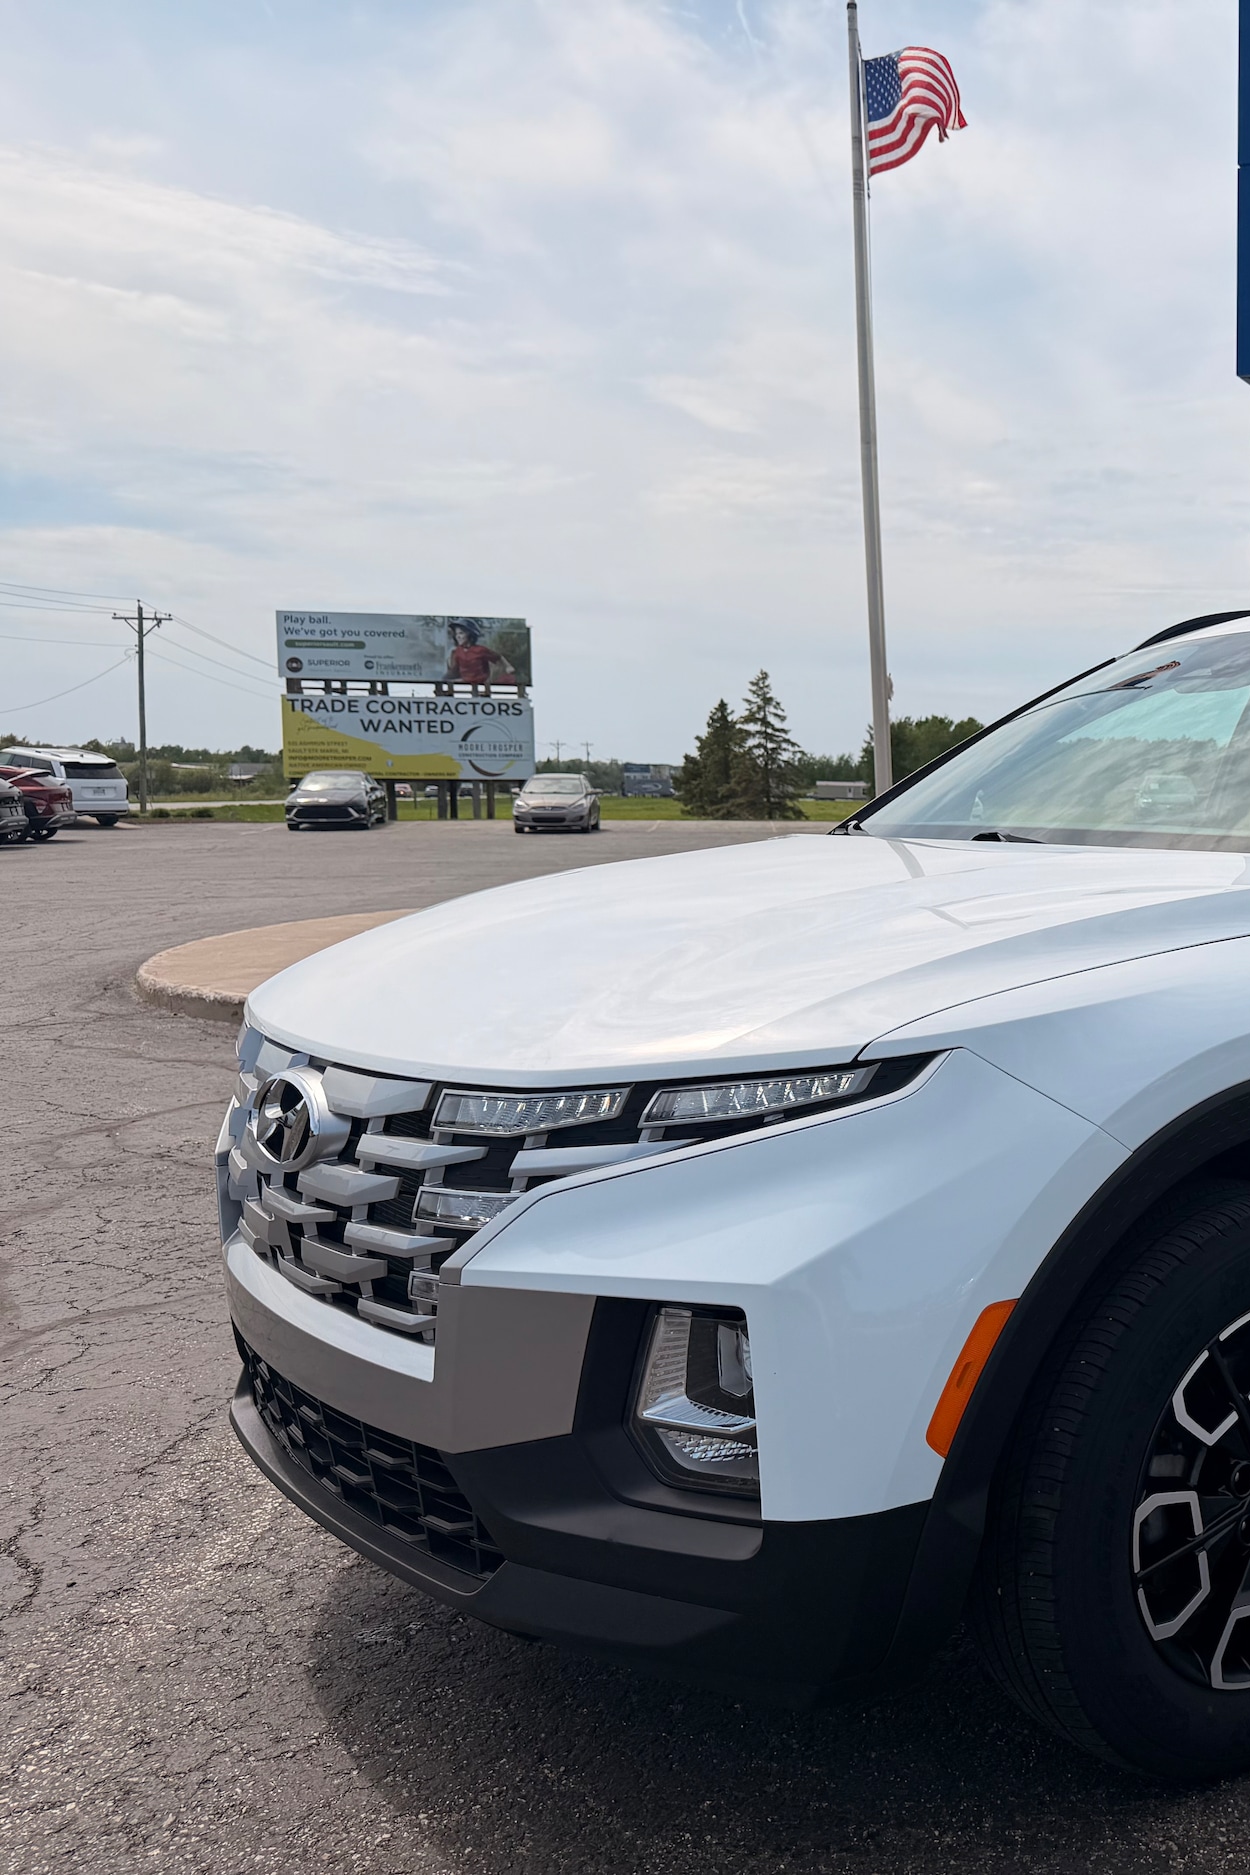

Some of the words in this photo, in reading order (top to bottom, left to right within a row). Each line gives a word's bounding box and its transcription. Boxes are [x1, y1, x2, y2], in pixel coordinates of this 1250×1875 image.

[283, 614, 306, 626] Play
[308, 615, 332, 625] ball.
[283, 626, 317, 636] We've
[319, 628, 338, 638] got
[340, 629, 361, 639] you
[363, 629, 409, 639] covered.
[307, 659, 351, 667] SUPERIOR
[289, 699, 359, 713] TRADE
[366, 701, 523, 716] CONTRACTORS
[359, 719, 455, 734] WANTED
[458, 743, 484, 751] MOORE
[488, 744, 523, 752] TROSPER
